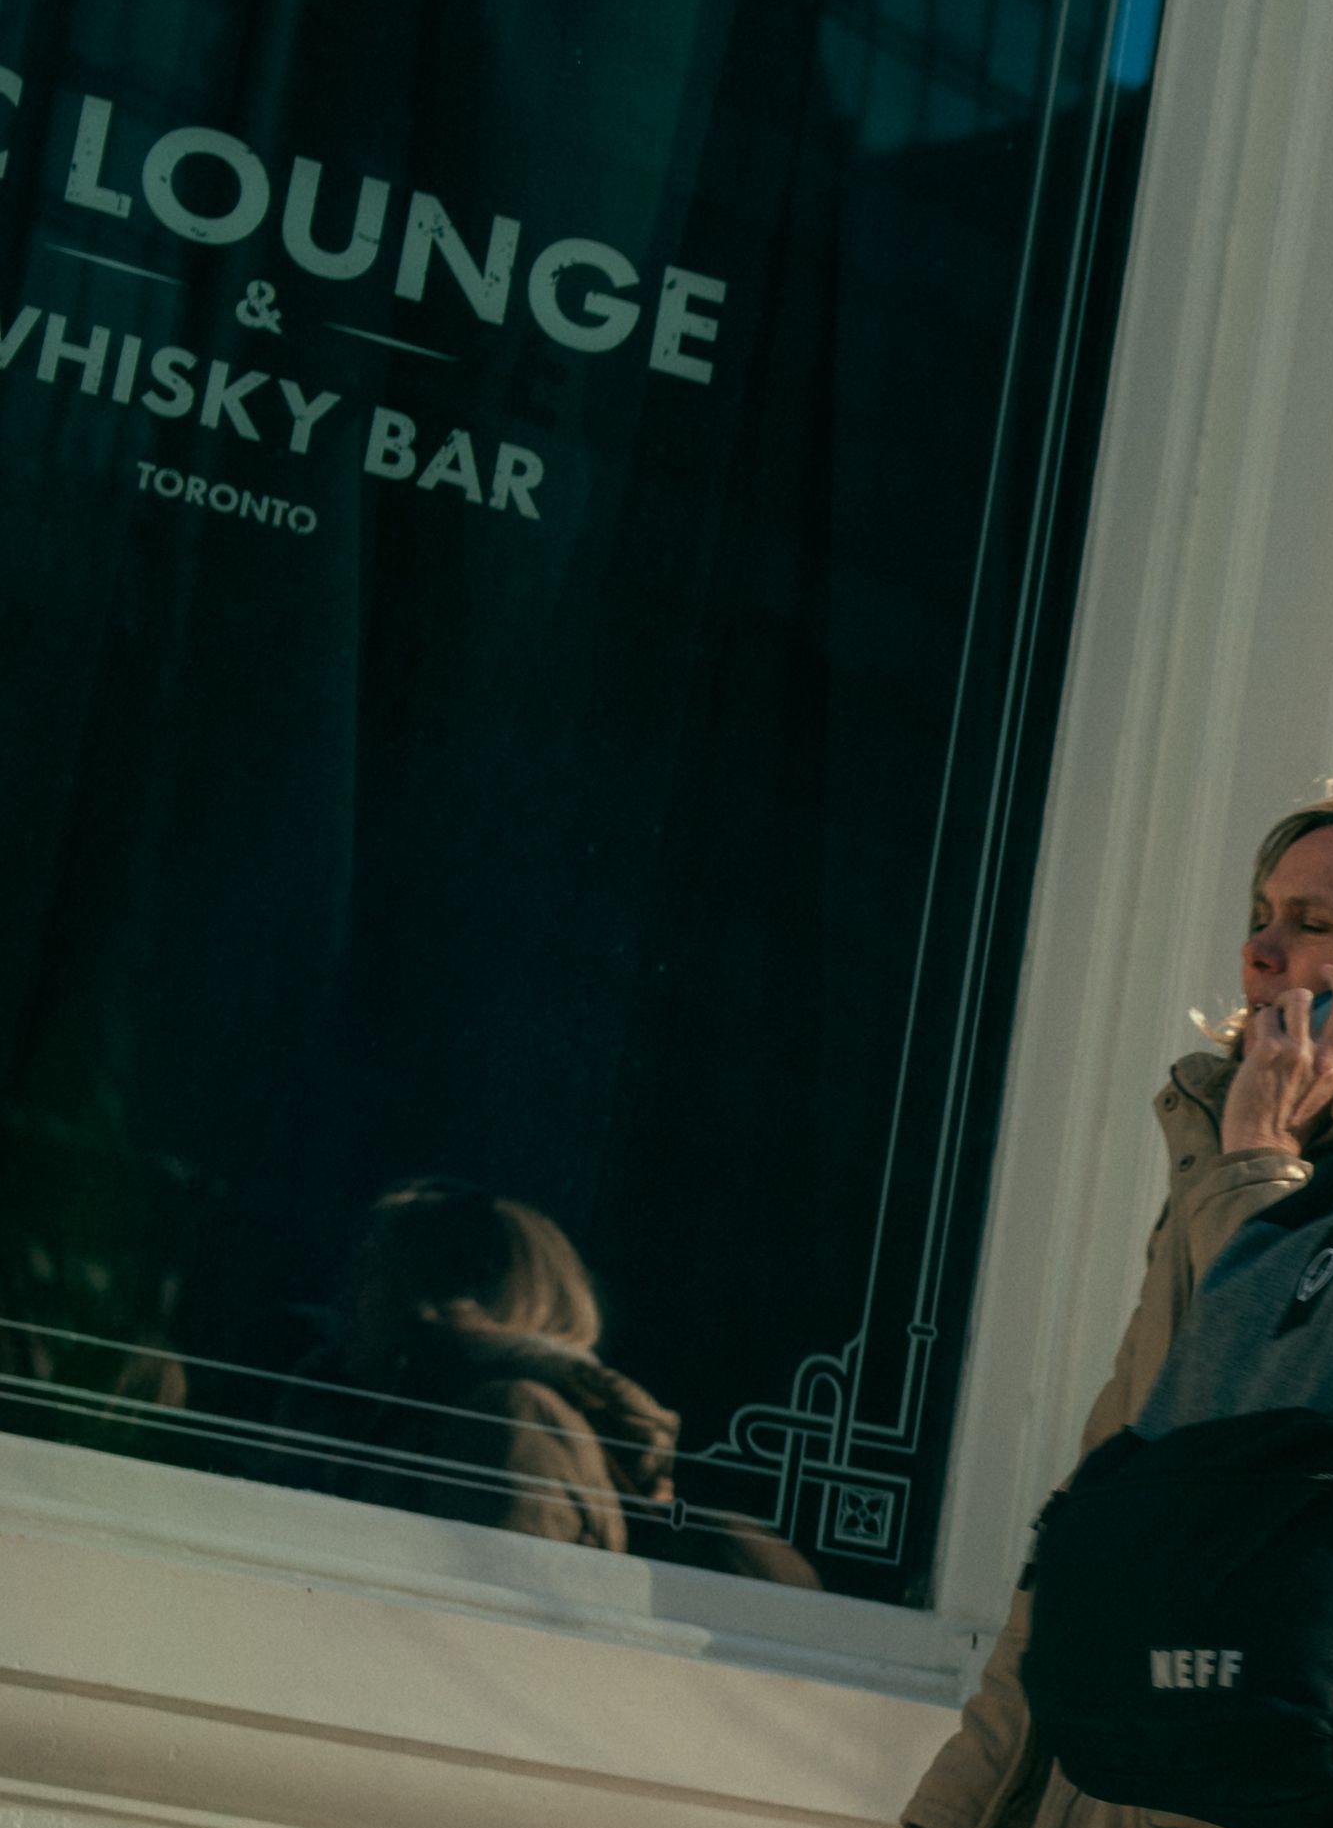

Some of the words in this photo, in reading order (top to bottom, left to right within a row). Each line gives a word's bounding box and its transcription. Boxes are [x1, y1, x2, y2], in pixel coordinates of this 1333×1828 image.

[64, 95, 727, 385] LOUNGE
[235, 278, 283, 334] &
[136, 460, 319, 535] TORONTO
[364, 406, 542, 520] BAR
[1150, 1649, 1244, 1689] NEFF
